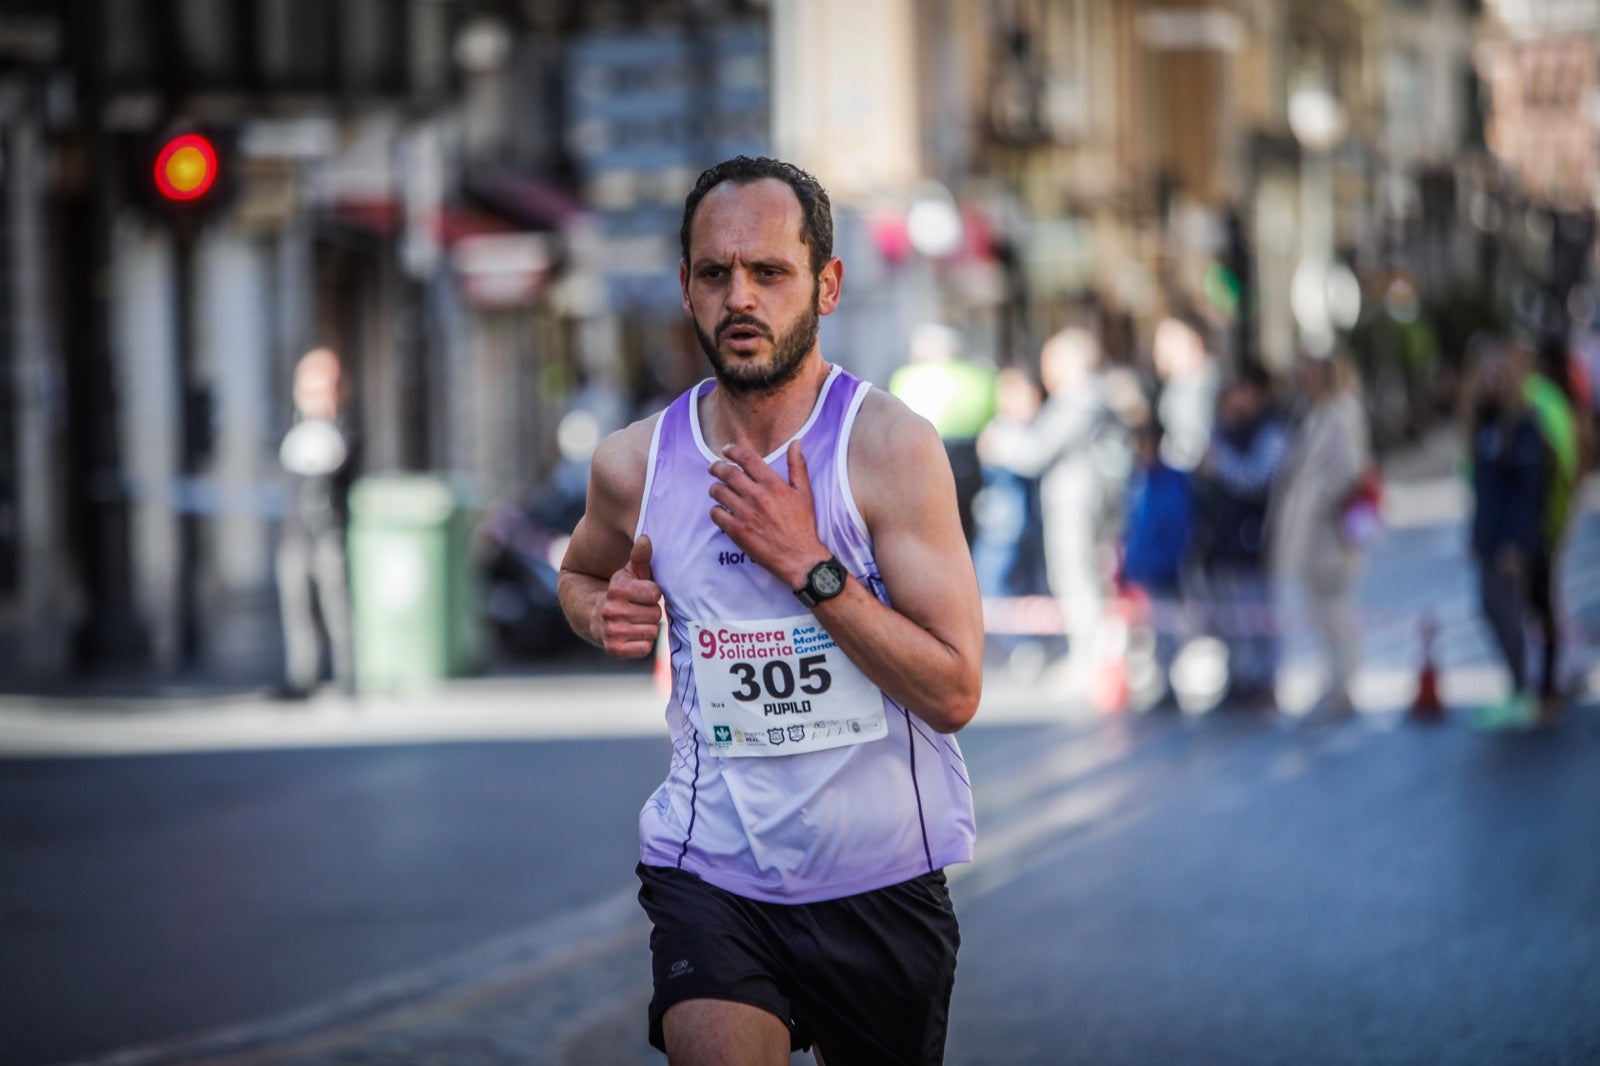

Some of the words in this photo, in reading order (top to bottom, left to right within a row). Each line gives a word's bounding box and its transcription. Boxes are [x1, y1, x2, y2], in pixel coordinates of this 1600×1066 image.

[717, 628, 785, 644] Carrera
[792, 627, 815, 636] Ave
[699, 629, 717, 659] 9
[719, 643, 793, 660] Solidaria
[729, 654, 832, 702] 305
[763, 700, 812, 716] PUPILO
